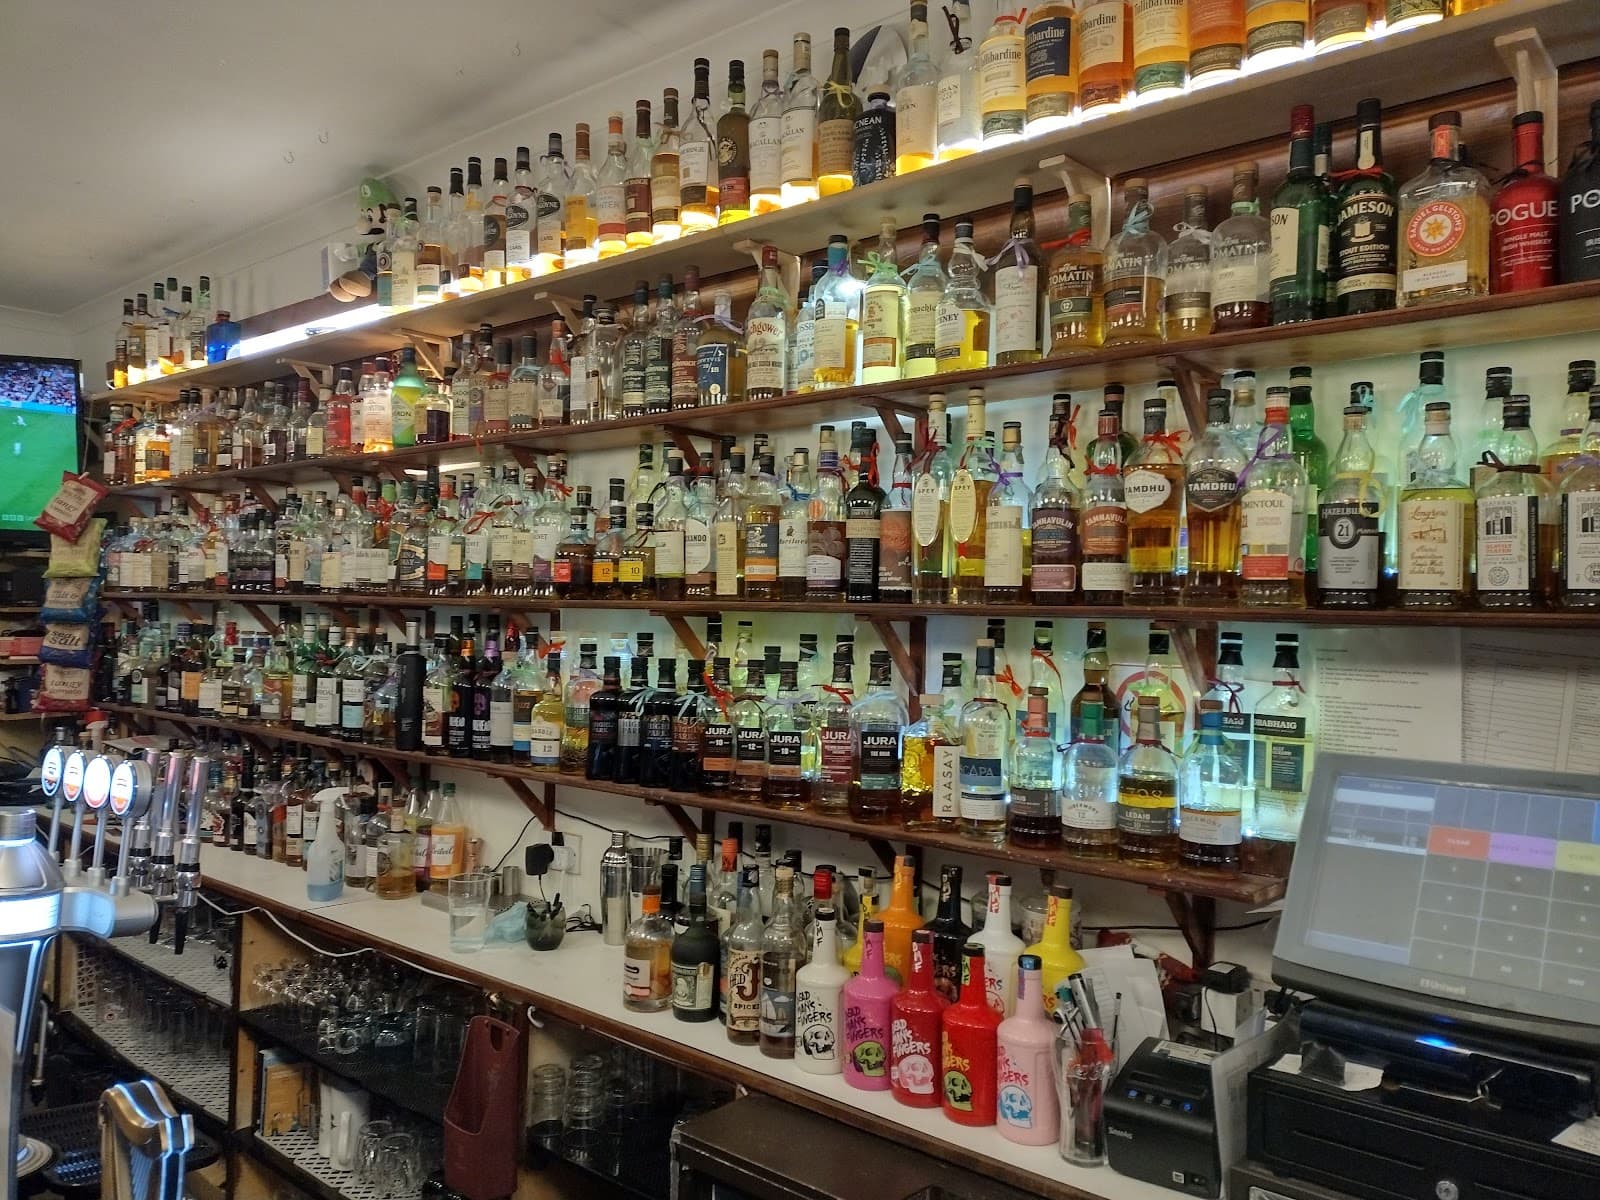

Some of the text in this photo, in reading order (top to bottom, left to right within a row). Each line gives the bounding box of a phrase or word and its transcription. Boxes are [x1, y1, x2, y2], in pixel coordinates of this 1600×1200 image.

[1125, 484, 1165, 494] TAMDHU
[1188, 482, 1236, 491] TAMDHU
[1338, 524, 1349, 537] 21
[631, 567, 640, 575] 10
[50, 635, 81, 647] salt
[770, 735, 801, 744] JURA
[863, 736, 897, 745] JURA
[942, 751, 953, 812] RAASAY
